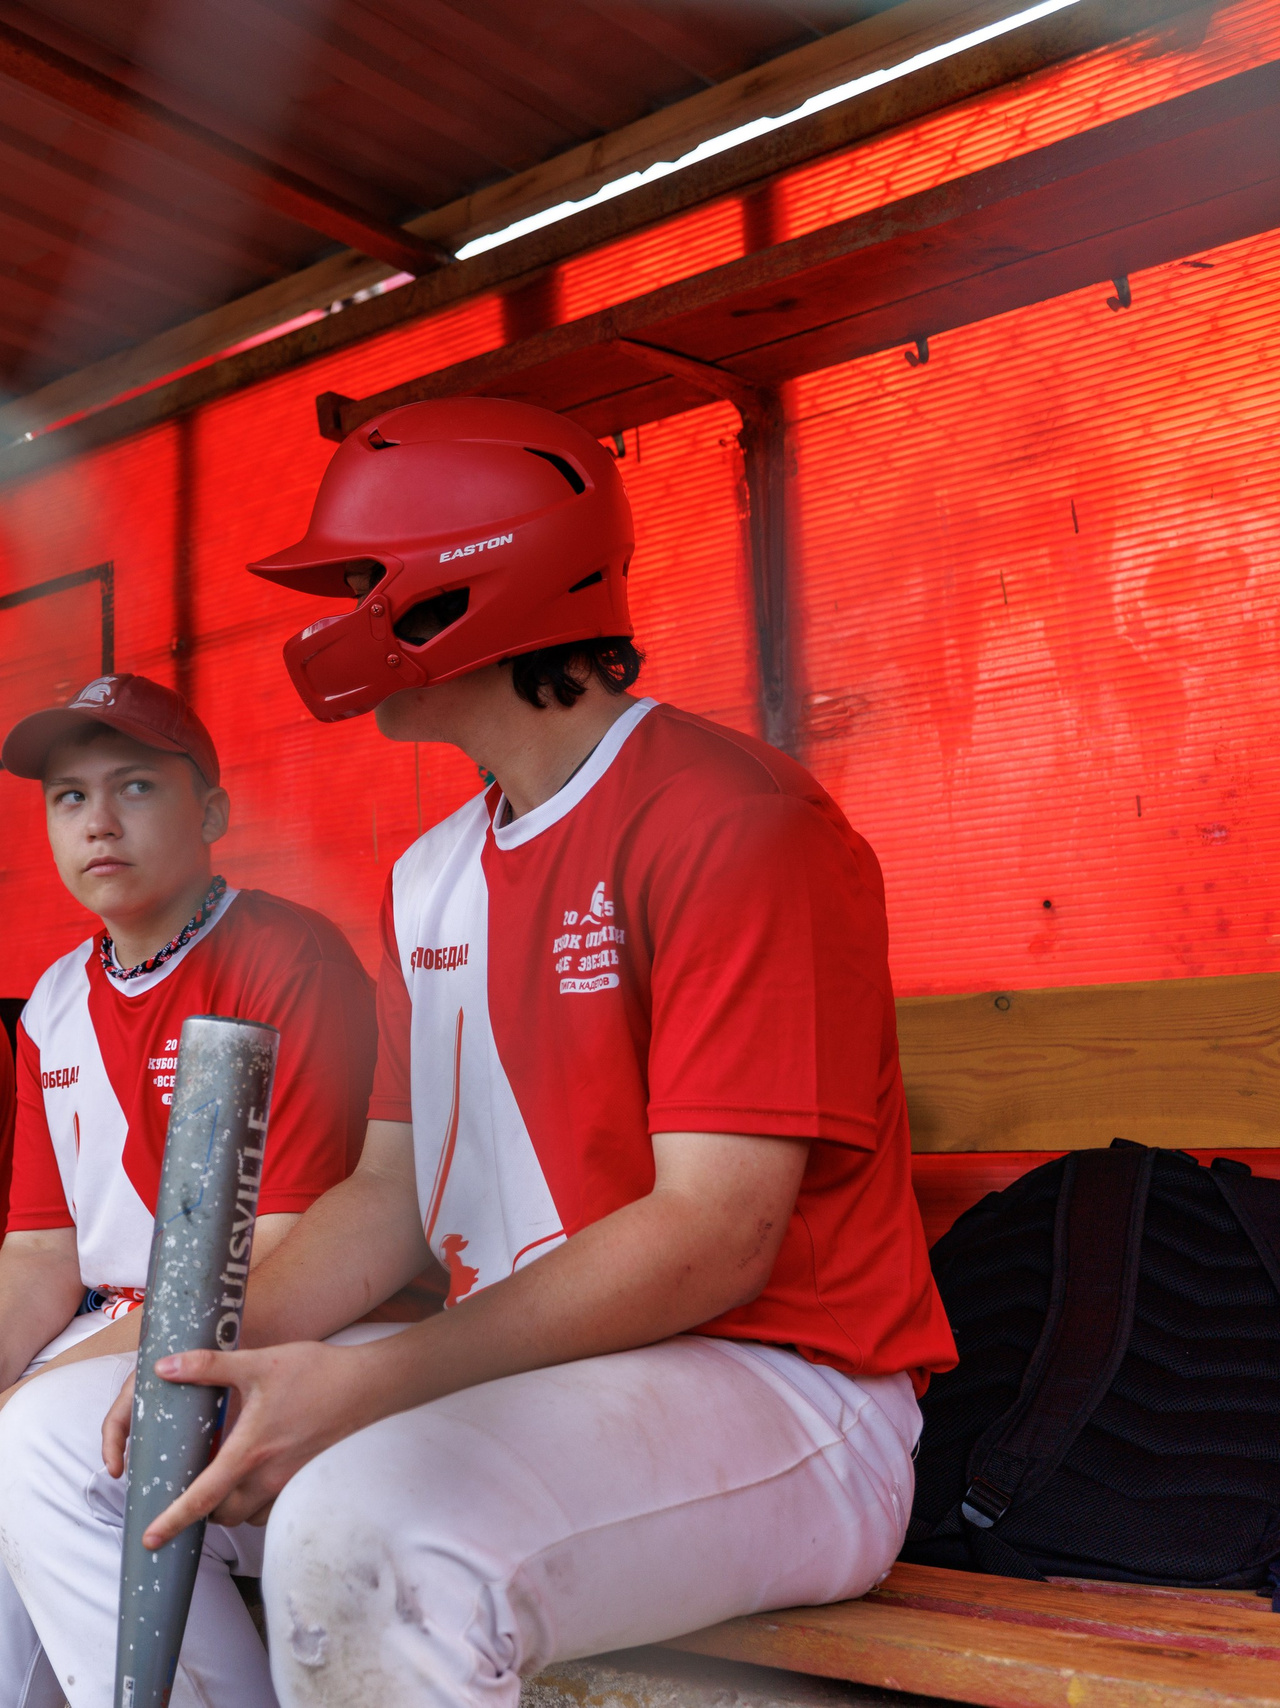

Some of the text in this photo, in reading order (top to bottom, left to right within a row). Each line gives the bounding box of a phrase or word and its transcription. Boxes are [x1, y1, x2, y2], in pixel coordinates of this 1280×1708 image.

[439, 533, 513, 563] EASTON
[165, 1039, 178, 1051] 20
[42, 1065, 80, 1090] ОБЕДА!
[215, 1105, 271, 1351] OUISVILLE
